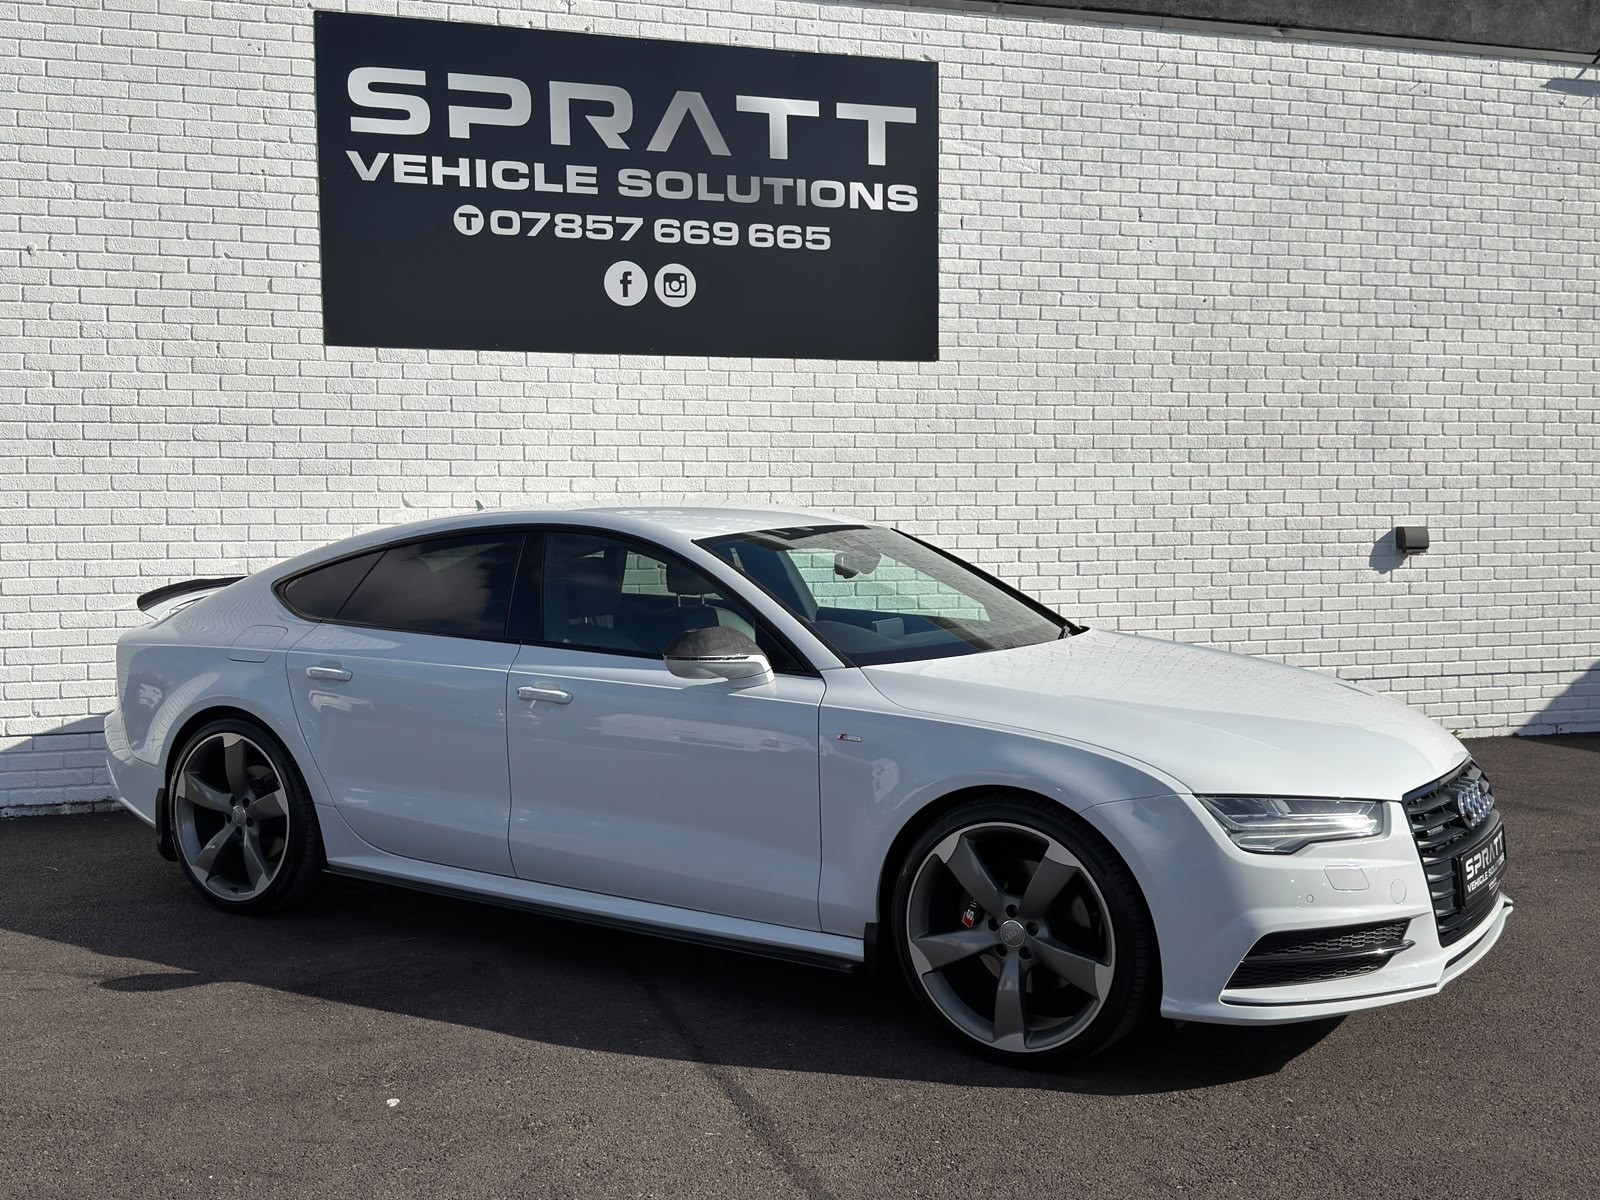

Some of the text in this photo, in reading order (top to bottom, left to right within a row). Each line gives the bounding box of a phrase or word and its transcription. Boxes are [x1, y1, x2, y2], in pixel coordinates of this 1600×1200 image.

[347, 66, 917, 167] SPRATT
[346, 150, 919, 213] VEHICLE SOLUTIONS
[489, 209, 644, 242] 07857
[653, 218, 740, 247] 669
[748, 223, 832, 251] 665
[1465, 830, 1503, 881] SPRATT
[1466, 870, 1489, 893] VEHICLE
